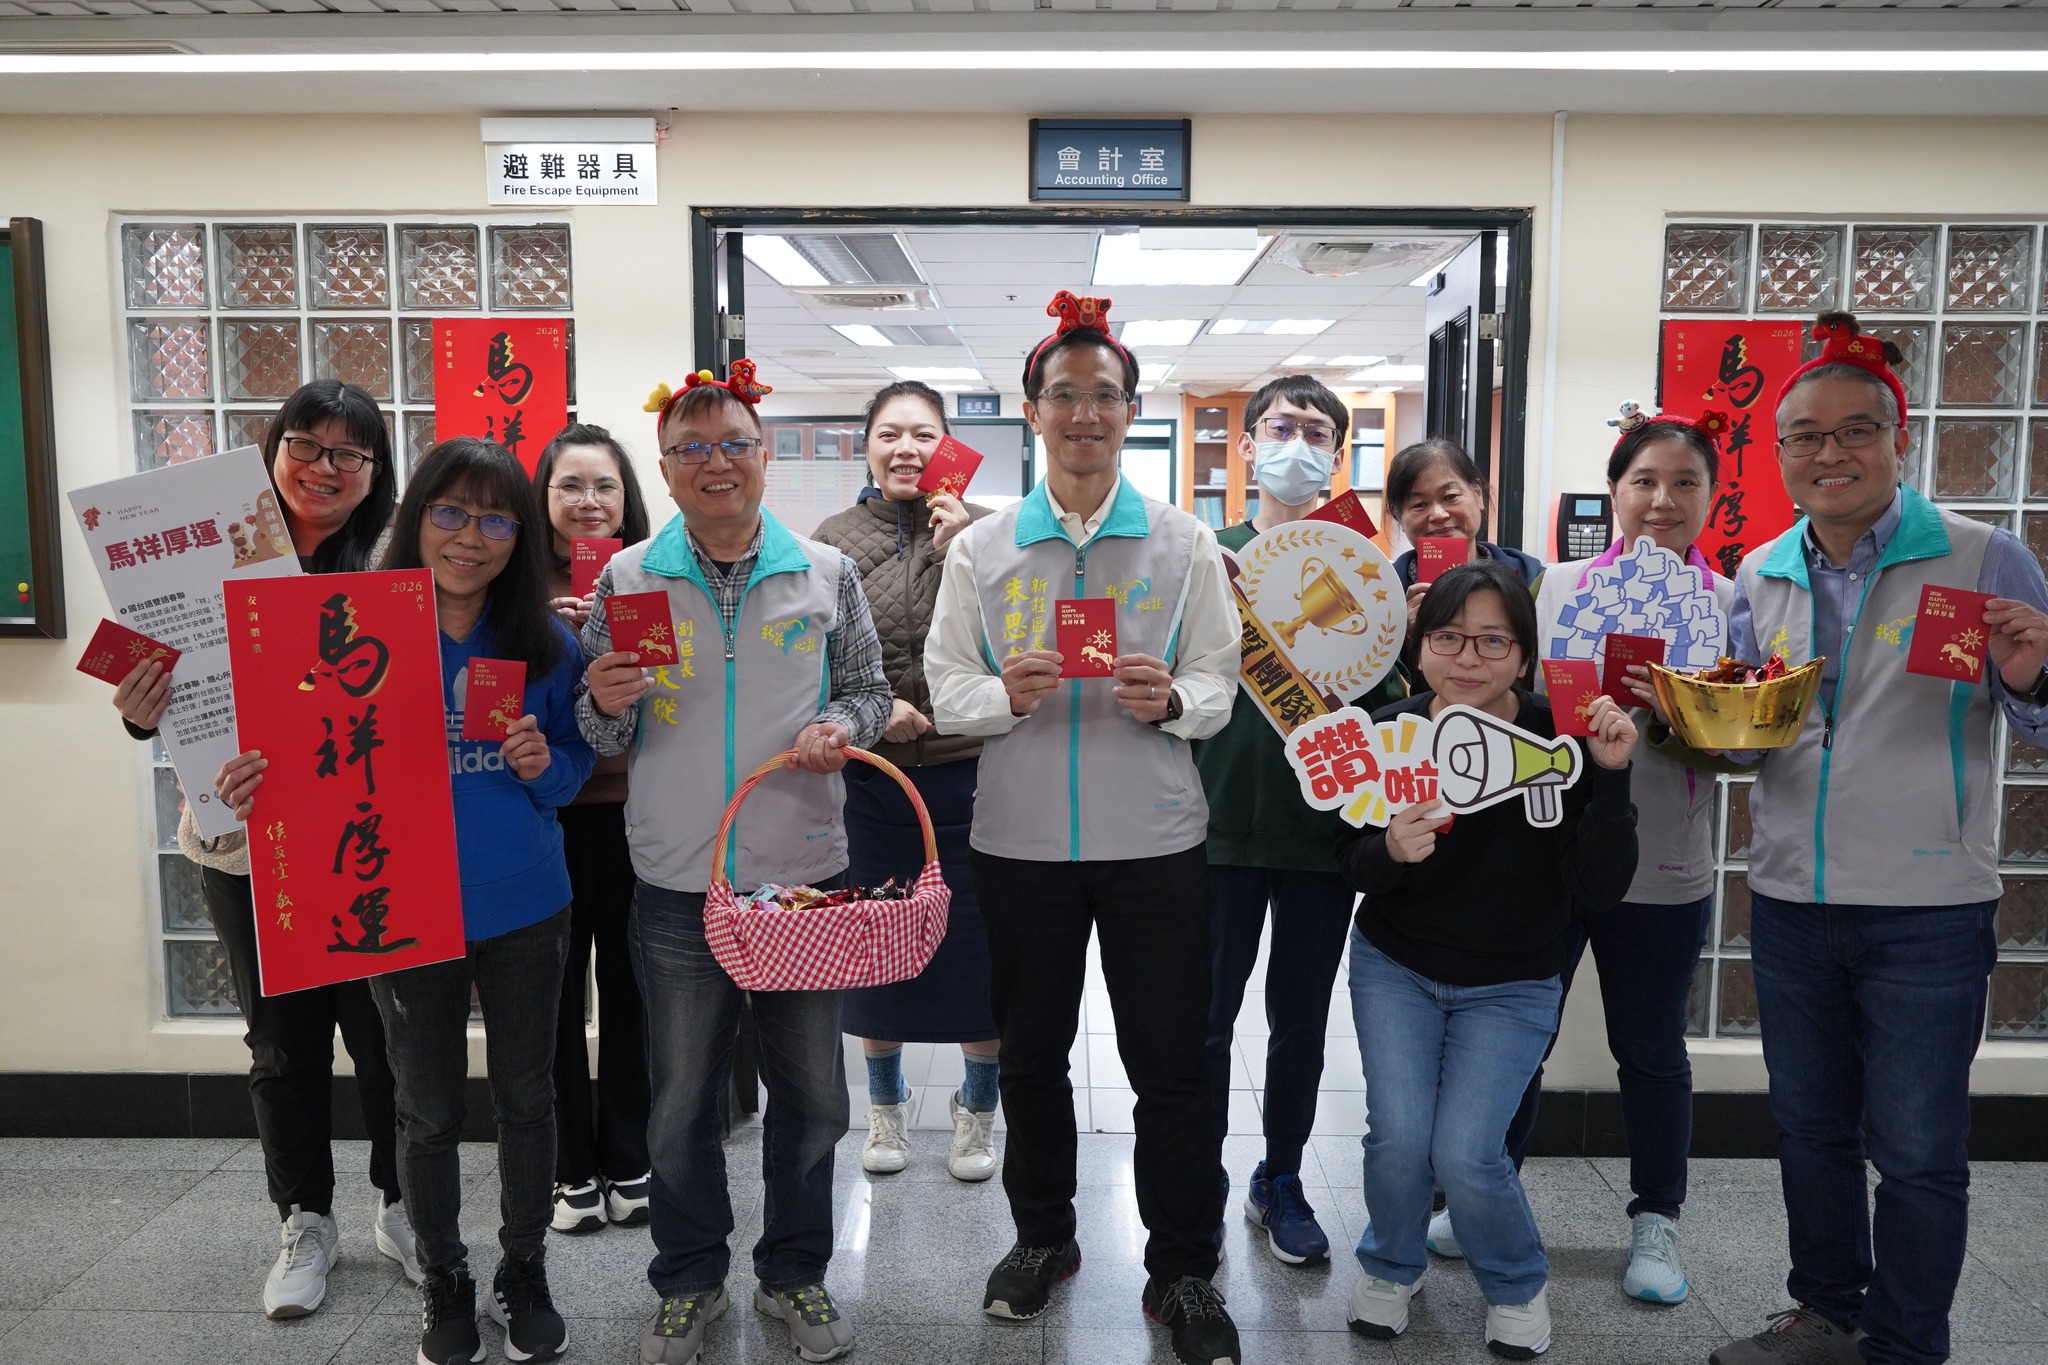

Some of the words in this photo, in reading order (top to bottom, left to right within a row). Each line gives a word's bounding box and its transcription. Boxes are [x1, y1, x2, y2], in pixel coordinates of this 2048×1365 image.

[503, 153, 638, 179] 避難器具
[1057, 146, 1165, 171] 會計室
[504, 185, 526, 195] Fire
[530, 185, 572, 197] Escape
[576, 185, 639, 197] Equipment
[1055, 173, 1125, 187] Accounting
[1132, 173, 1168, 185] Office
[536, 327, 559, 335] 2026
[1771, 329, 1794, 338] 2026
[117, 504, 142, 516] HAPPY
[119, 512, 136, 522] NEW
[138, 507, 160, 518] YEAR
[261, 497, 286, 547] 馬祥厚運
[105, 518, 223, 571] 馬祥厚運
[391, 580, 423, 593] 2026
[127, 591, 186, 613] 國台語雙語春聯
[416, 594, 425, 612] 丙午
[247, 595, 262, 653] 安駒樂業
[1031, 577, 1048, 651] 新莊區長
[678, 619, 696, 678] 副區長
[1239, 607, 1316, 727] 質團隊
[167, 683, 232, 706] 祥厚運的台語有三
[172, 705, 234, 728] 也可以念運馬祥厚(
[176, 715, 235, 737] 怎麼順怎麼念，選
[1296, 718, 1439, 805] 讚啦
[298, 593, 421, 954] 馬祥厚運
[276, 889, 293, 931] 敬賀
